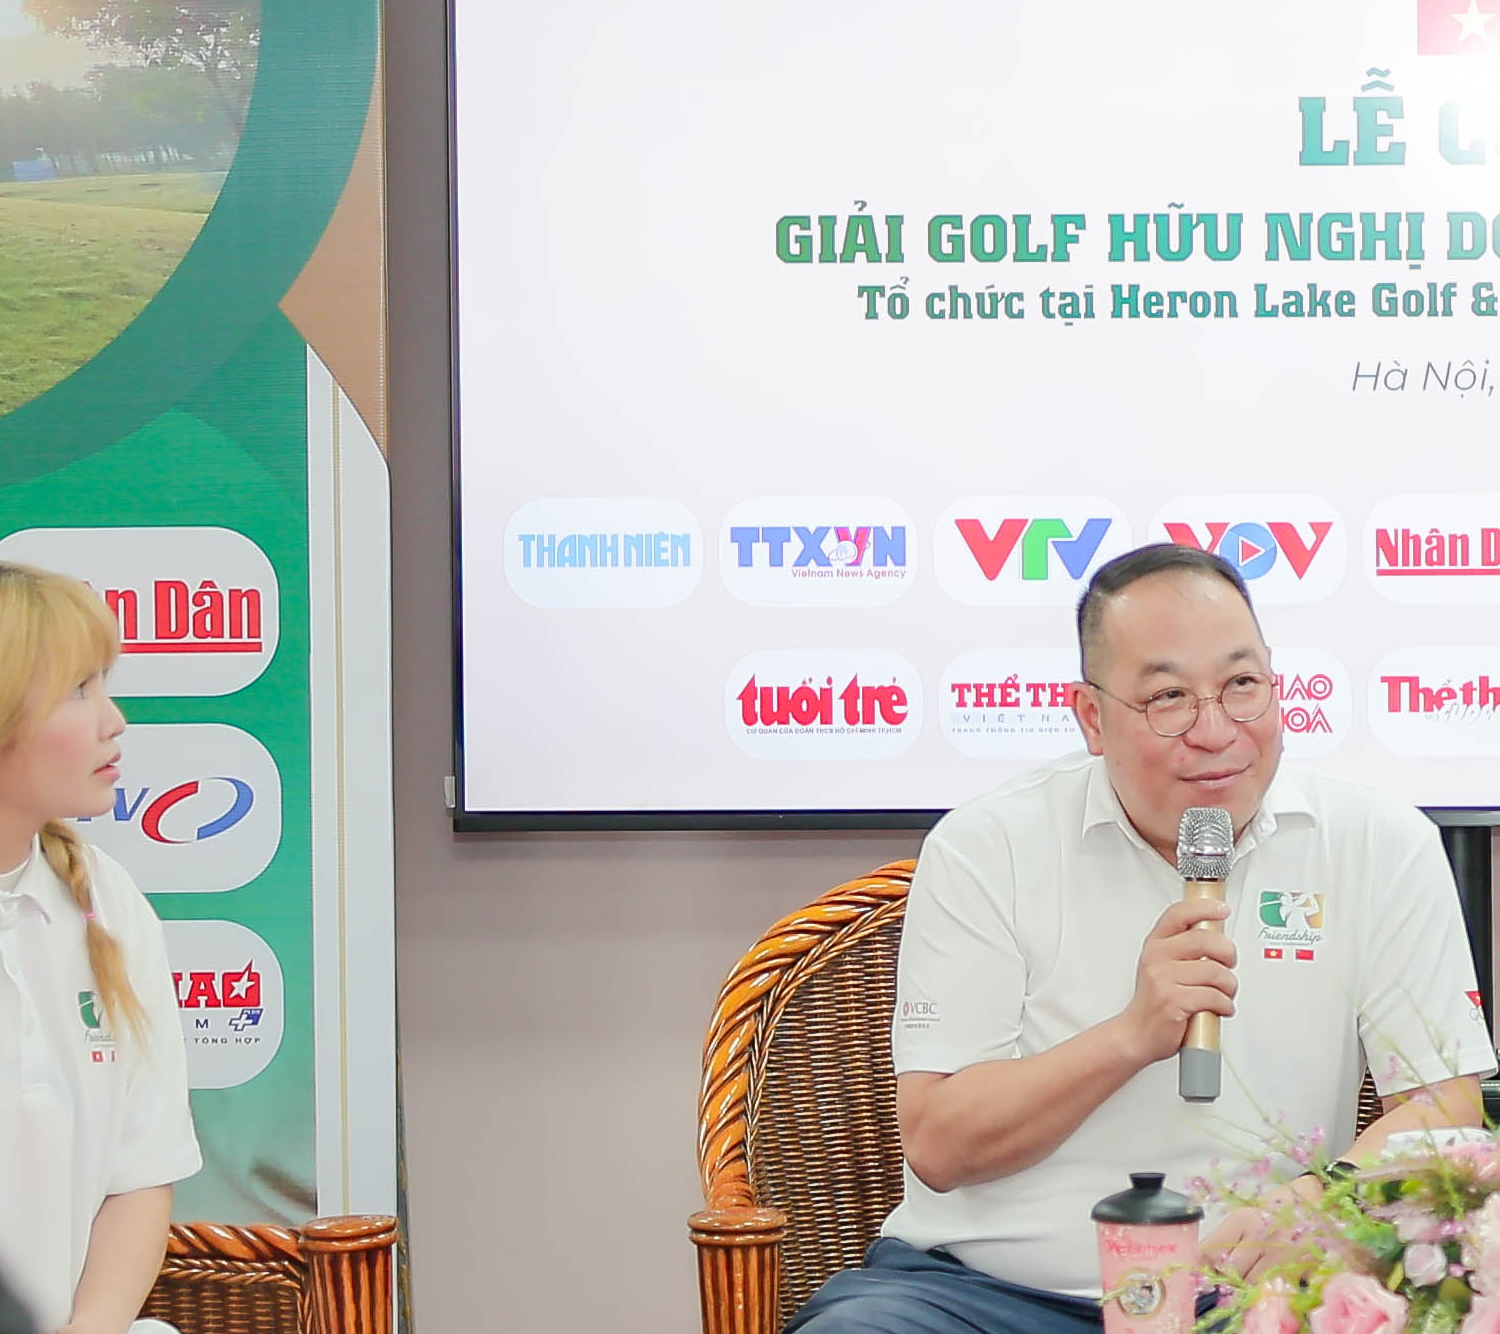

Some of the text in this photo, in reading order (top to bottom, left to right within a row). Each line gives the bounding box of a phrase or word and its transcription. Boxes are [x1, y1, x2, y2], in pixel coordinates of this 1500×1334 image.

[1299, 66, 1406, 167] LỄ
[775, 200, 905, 264] GIẢI
[927, 213, 1087, 264] GOLF
[1108, 202, 1244, 263] HỮU
[1264, 211, 1425, 271] NGHỊ
[857, 276, 911, 321] Tổ
[924, 280, 1026, 321] chức
[1040, 282, 1096, 327] tại
[1110, 283, 1239, 320] Heron
[1254, 282, 1358, 319] Lake
[1371, 281, 1459, 319] Golf
[1351, 360, 1408, 394] Hà
[1422, 359, 1496, 398] Nội,
[517, 530, 691, 568] THANH NIÊN
[954, 517, 1113, 581] VTV
[1375, 527, 1470, 568] Nhân
[790, 568, 907, 580] Vietnam News Agency
[154, 579, 262, 640] Dân
[736, 672, 834, 726] tuổi
